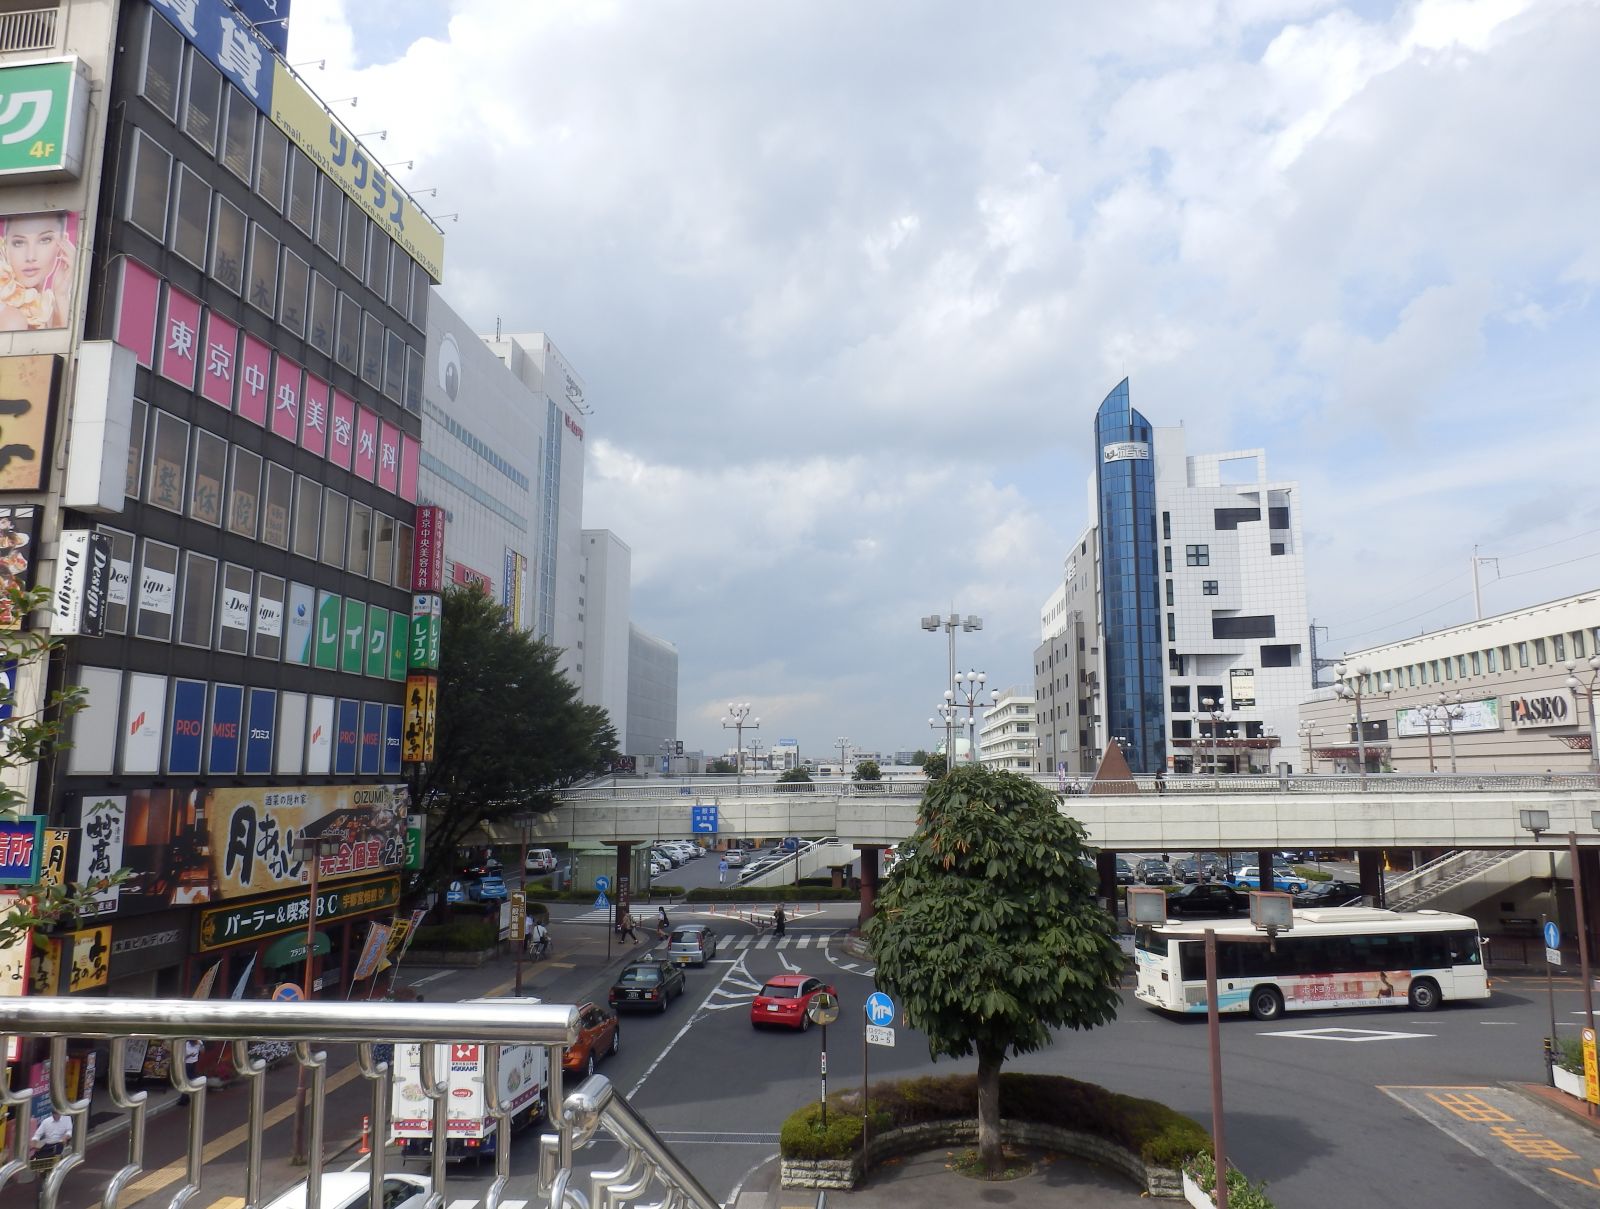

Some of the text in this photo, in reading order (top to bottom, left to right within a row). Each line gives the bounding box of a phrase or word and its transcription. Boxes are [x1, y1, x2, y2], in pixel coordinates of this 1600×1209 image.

[29, 140, 55, 158] 4F
[168, 318, 397, 473] 東京中央美容外科
[418, 509, 431, 588] 東京中央美容外科
[58, 549, 80, 617] Design
[87, 546, 107, 618] Design
[322, 617, 385, 654] レイク
[413, 623, 427, 661] レイク
[1510, 695, 1567, 722] PASEO
[251, 728, 270, 739] プロミス
[387, 737, 400, 746] プロミス
[354, 789, 385, 804] OIZUMI
[55, 831, 69, 840] 2F
[406, 832, 416, 865] レイク
[385, 838, 404, 866] 2F
